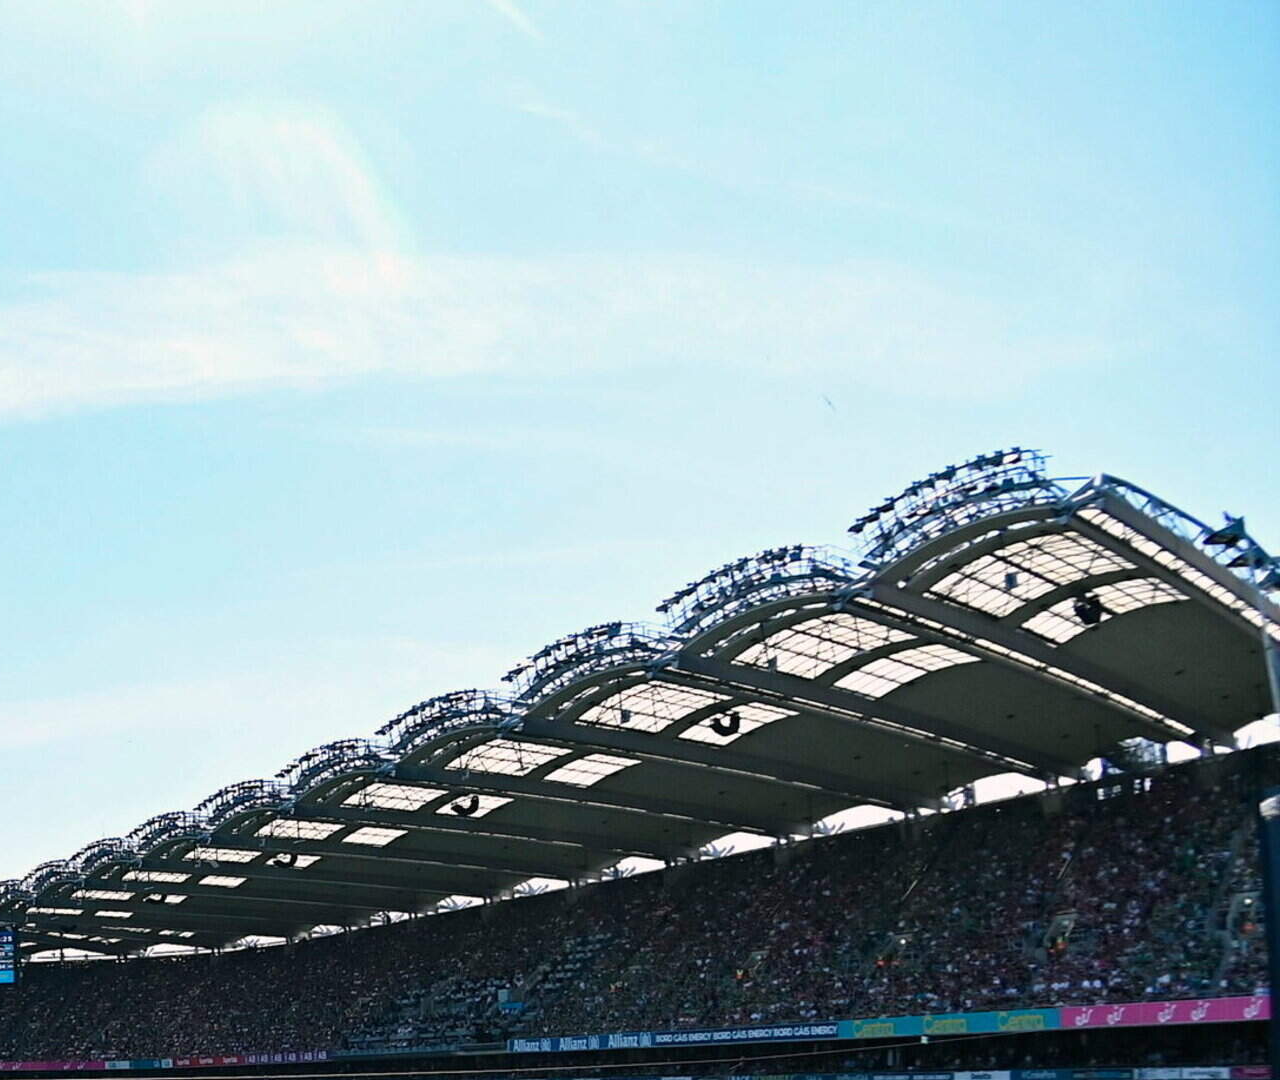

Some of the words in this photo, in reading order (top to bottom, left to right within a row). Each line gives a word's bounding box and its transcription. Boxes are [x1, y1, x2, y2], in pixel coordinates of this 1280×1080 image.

[713, 1032, 730, 1040] BORD
[748, 1029, 772, 1038] ENERGY
[774, 1028, 793, 1037] BORD
[811, 1026, 837, 1035] ENERGY
[559, 1037, 587, 1050] Allianz
[608, 1034, 638, 1048] Allianz
[656, 1035, 672, 1043] BORD
[689, 1033, 711, 1042] ENERGY
[513, 1040, 539, 1051] Allianz
